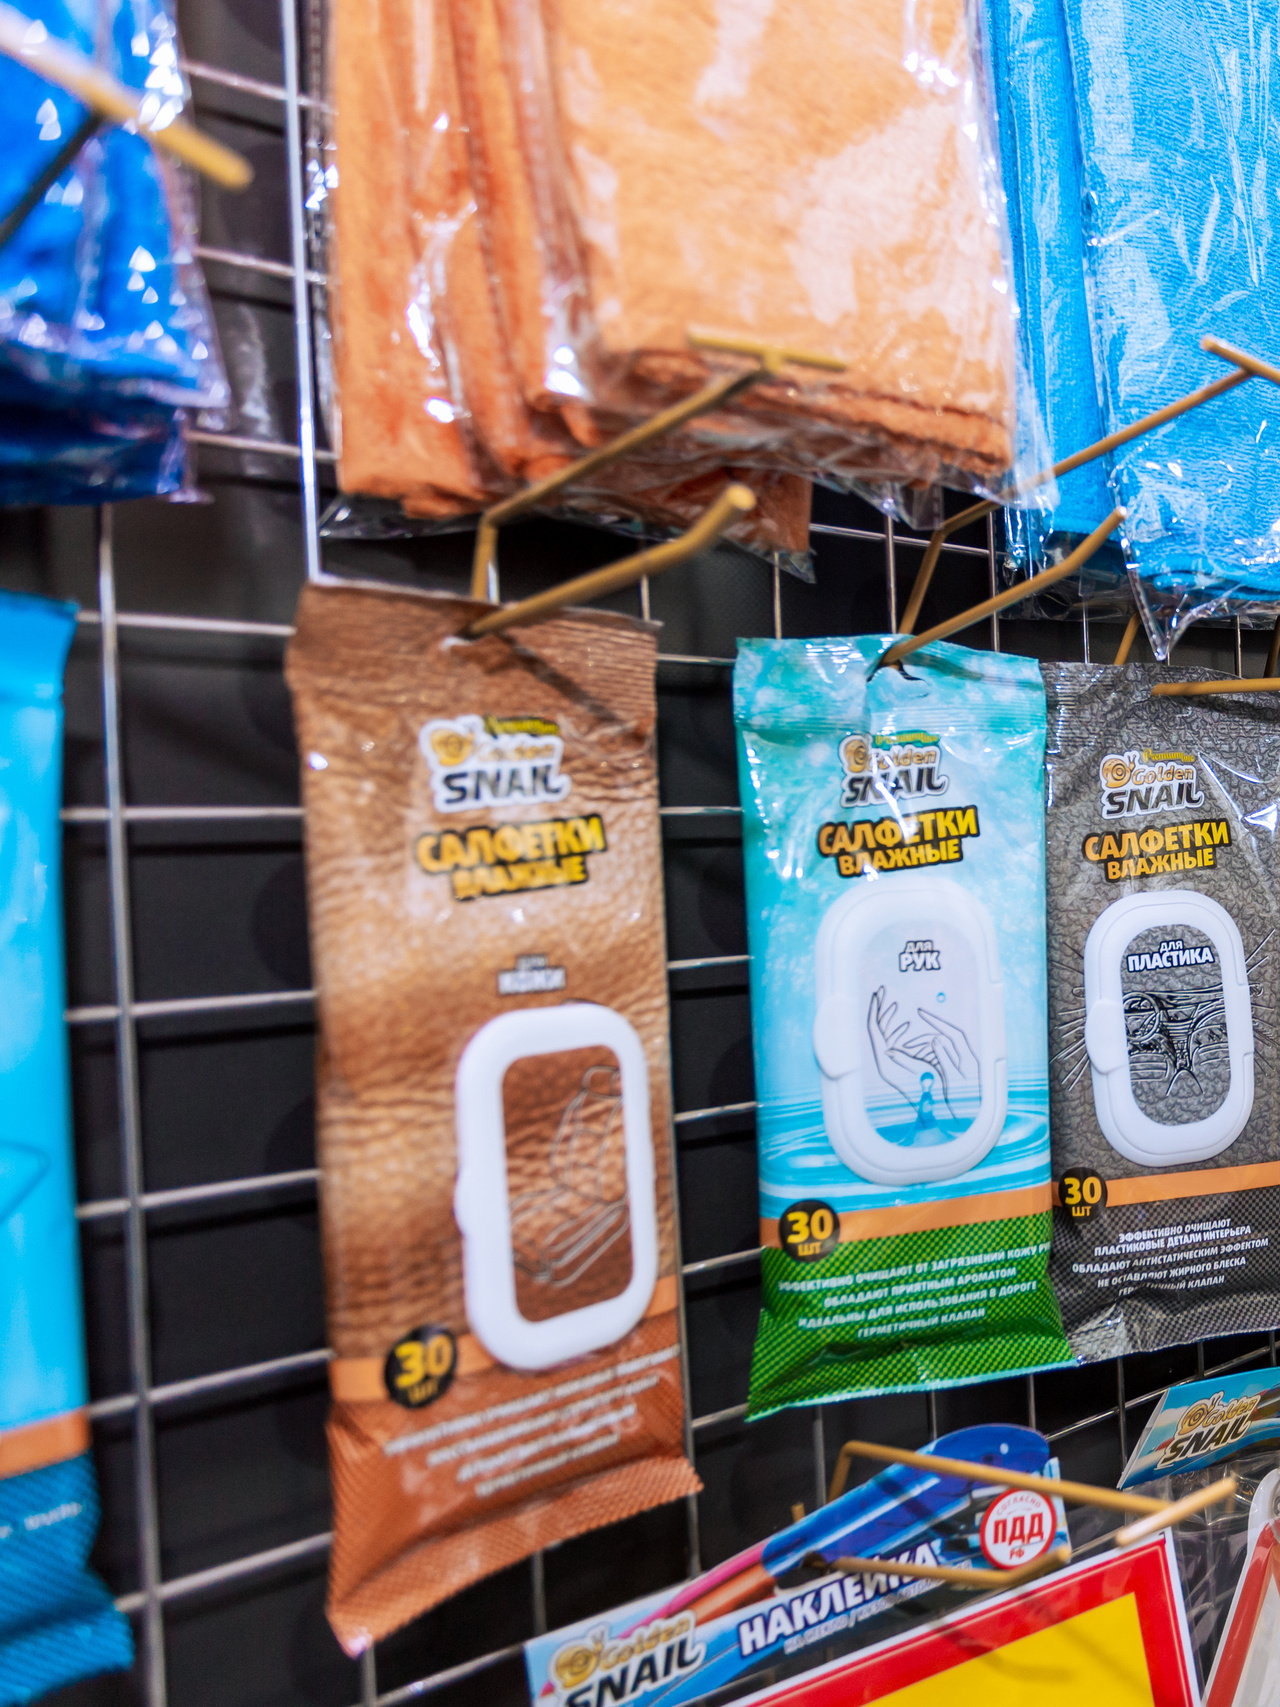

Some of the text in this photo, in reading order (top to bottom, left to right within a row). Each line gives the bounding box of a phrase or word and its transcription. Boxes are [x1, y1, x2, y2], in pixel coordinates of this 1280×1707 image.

[443, 765, 563, 804] SNAIL
[846, 766, 946, 803] SNAIL
[1132, 765, 1194, 785] Golden
[1106, 782, 1202, 815] SNAIL
[417, 815, 606, 874] САЛФЕТКИ
[819, 808, 978, 855] САЛФЕТКИ
[1084, 821, 1230, 861] САЛФЕТКИ
[838, 840, 961, 876] ВЛАЖНЫЕ
[1107, 847, 1215, 880] ВЛАЖНЫЕ
[900, 951, 941, 972] РУК
[1127, 947, 1214, 972] ПЛАСТИКА
[1159, 941, 1184, 954] ДЛЯ
[1064, 1176, 1102, 1205] 30
[786, 1208, 834, 1243] 30
[1072, 1205, 1092, 1217] ШТ
[1094, 1225, 1252, 1257] ПЛАСТИКОВЫЕ ДЕТАЛИ ИНТЕРЬЕРА
[1118, 1218, 1231, 1243] ЭФФЕКТИВНО ОЧИЩАЮТ
[797, 1241, 821, 1257] ШТ
[1072, 1237, 1269, 1274] ОБЛАДАЮТ АНТИСТАТИЧЕСКИМ ЭФФЕКТОМ
[778, 1274, 854, 1291] ЭФФЕКТИВНО
[855, 1264, 913, 1283] ОЧИЩАЮТ
[915, 1263, 928, 1274] ОТ
[931, 1248, 1005, 1271] ЗАГРЯЗНЕНИЙ
[1007, 1245, 1037, 1259] КОЖУ
[1097, 1256, 1247, 1289] НЕ ОСТАВЛЯЮТ ЖИРНОГО БЛЕСКА
[1187, 1275, 1225, 1289] КЛАПАН
[824, 1267, 1017, 1308] ОБЛАДАЮТ ПРИЯТНЫМ АРОМАТОМ
[798, 1281, 1037, 1329] ИДЕАЛЬНЫ ДЛЯ ИСПОЛЬЗОВАНИЯ В ДОРОГЕ
[857, 1308, 986, 1338] ГЕРМЕТИЧНЫЙ КЛАПАН
[394, 1334, 452, 1389] 30
[1201, 1397, 1257, 1428] Golden
[1160, 1415, 1251, 1466] SNAIL
[993, 1512, 1044, 1547] ПДД
[1009, 1547, 1025, 1561] РФ
[739, 1542, 940, 1656] НАКЛЕЙКА
[600, 1617, 691, 1671] Golden
